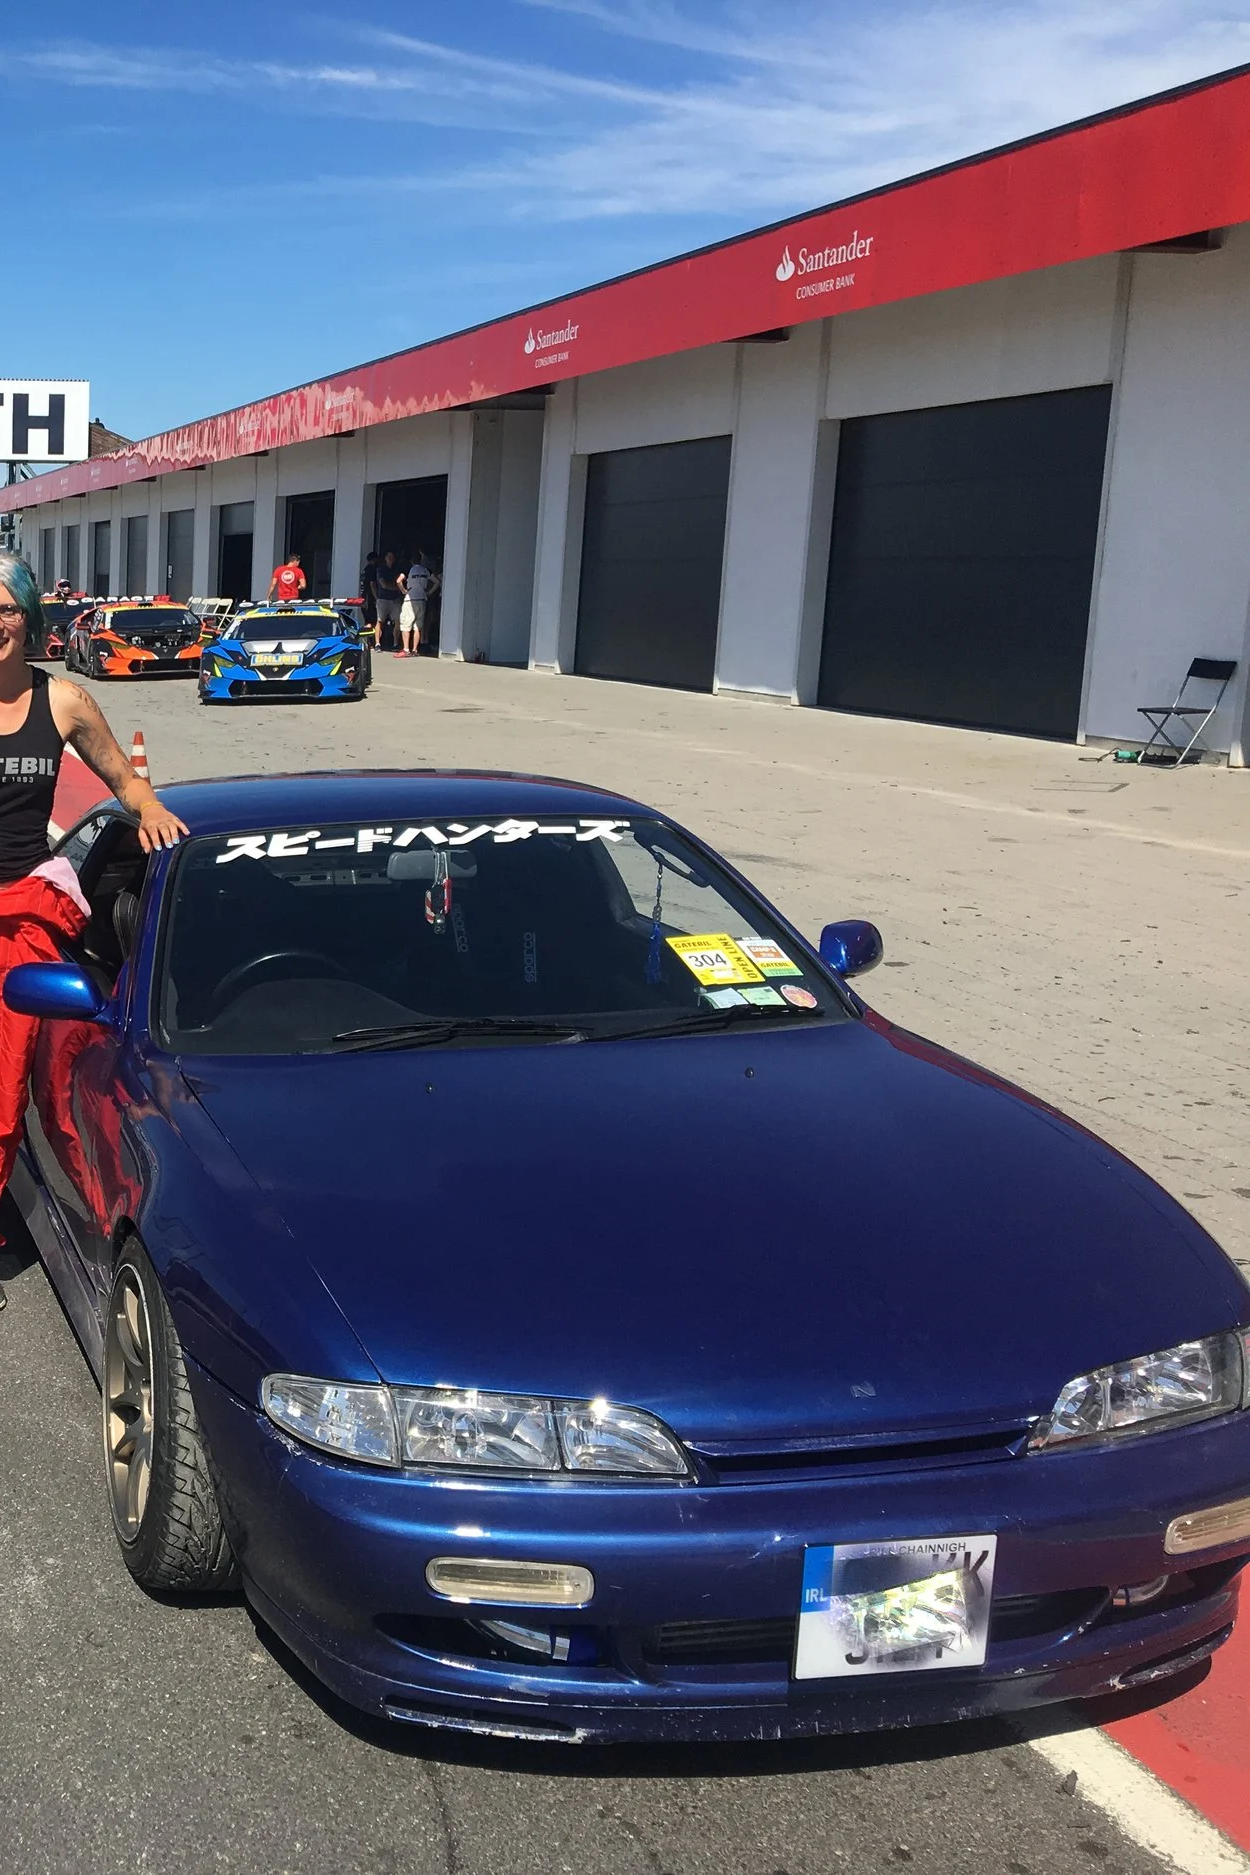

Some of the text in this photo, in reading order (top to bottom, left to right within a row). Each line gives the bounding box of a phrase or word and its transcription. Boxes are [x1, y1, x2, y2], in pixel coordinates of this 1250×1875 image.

[797, 230, 874, 275] Santander
[796, 273, 856, 300] CONSUMER BANK
[536, 319, 579, 350] Santander
[216, 818, 630, 864] スピードハンターズ
[674, 940, 712, 949] GATEBIL
[717, 936, 758, 979] OPEN LINE
[688, 953, 727, 968] 304
[899, 1542, 967, 1555] CHAINNIGH
[805, 1588, 828, 1604] IRL
